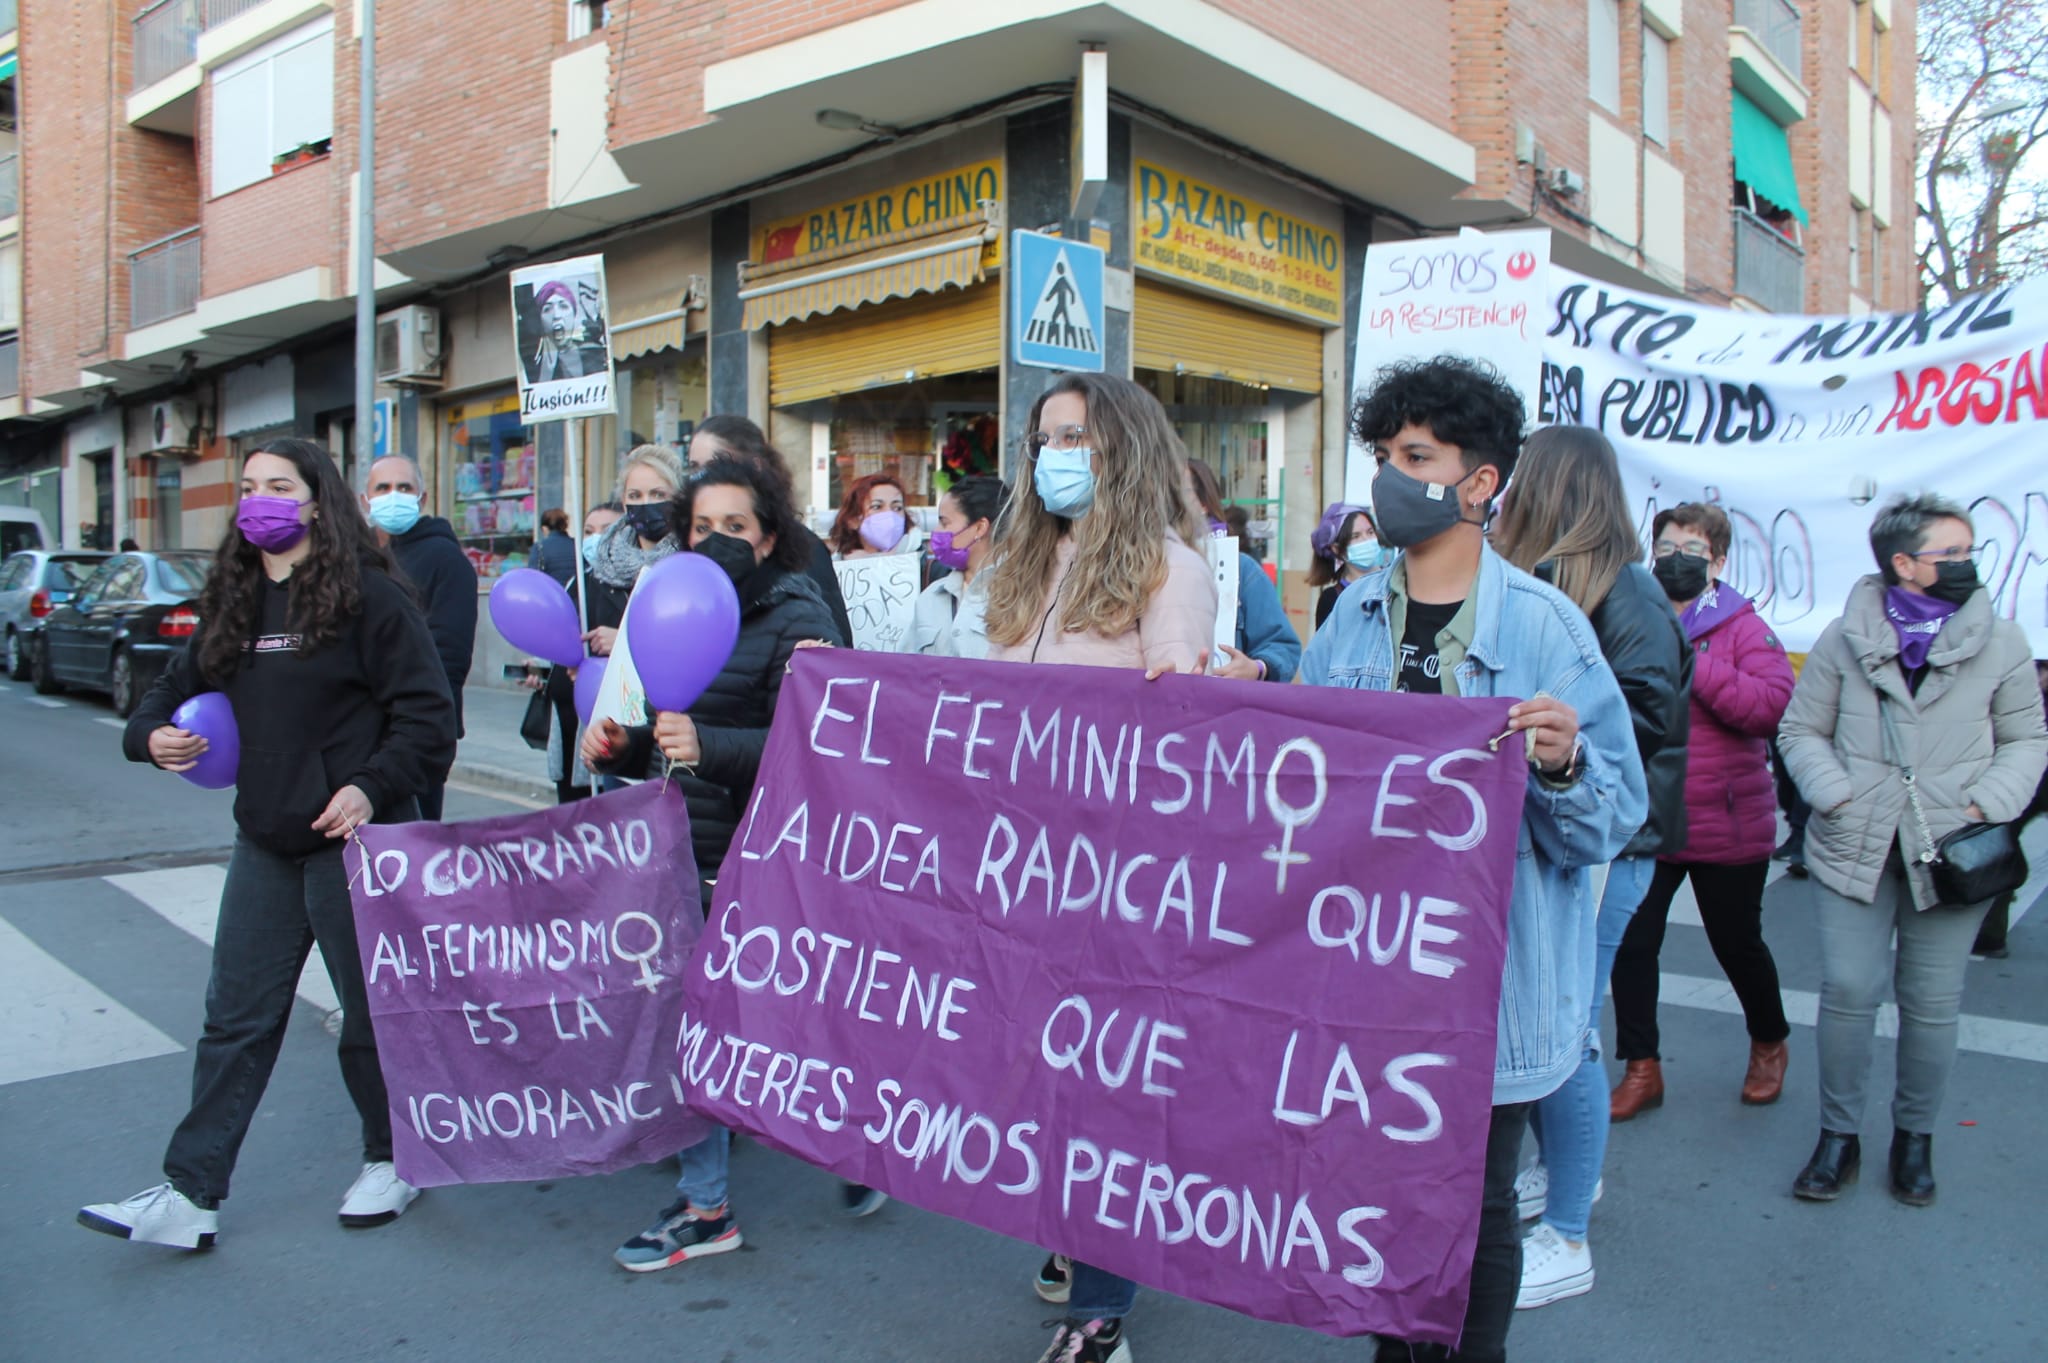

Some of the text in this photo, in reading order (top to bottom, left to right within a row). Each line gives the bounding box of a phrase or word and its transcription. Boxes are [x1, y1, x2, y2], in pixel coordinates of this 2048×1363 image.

[809, 167, 997, 252] BAZAR CHINO
[1140, 165, 1246, 240] BAZAR
[1258, 211, 1338, 272] CHINO
[1205, 236, 1245, 262] desde
[1379, 249, 1497, 297] SOMOS
[1370, 307, 1395, 338] LA
[1547, 284, 1697, 360] AYTO.
[1773, 287, 2013, 363] MOTRIL
[521, 384, 608, 415] Ilusión!!!
[838, 567, 870, 600] OS
[810, 677, 1495, 894] EL FEMINISMO ES
[361, 819, 651, 897] LO CONTRARIO
[975, 812, 1254, 948] RADICAL
[1307, 884, 1469, 979] QUE
[369, 911, 663, 993] AL FEMINISMO
[462, 992, 614, 1045] ES LA
[704, 900, 1457, 1144] SOSTIENE QUE LAS
[676, 1011, 1389, 1288] MUJERES SOMOS PERSONAS
